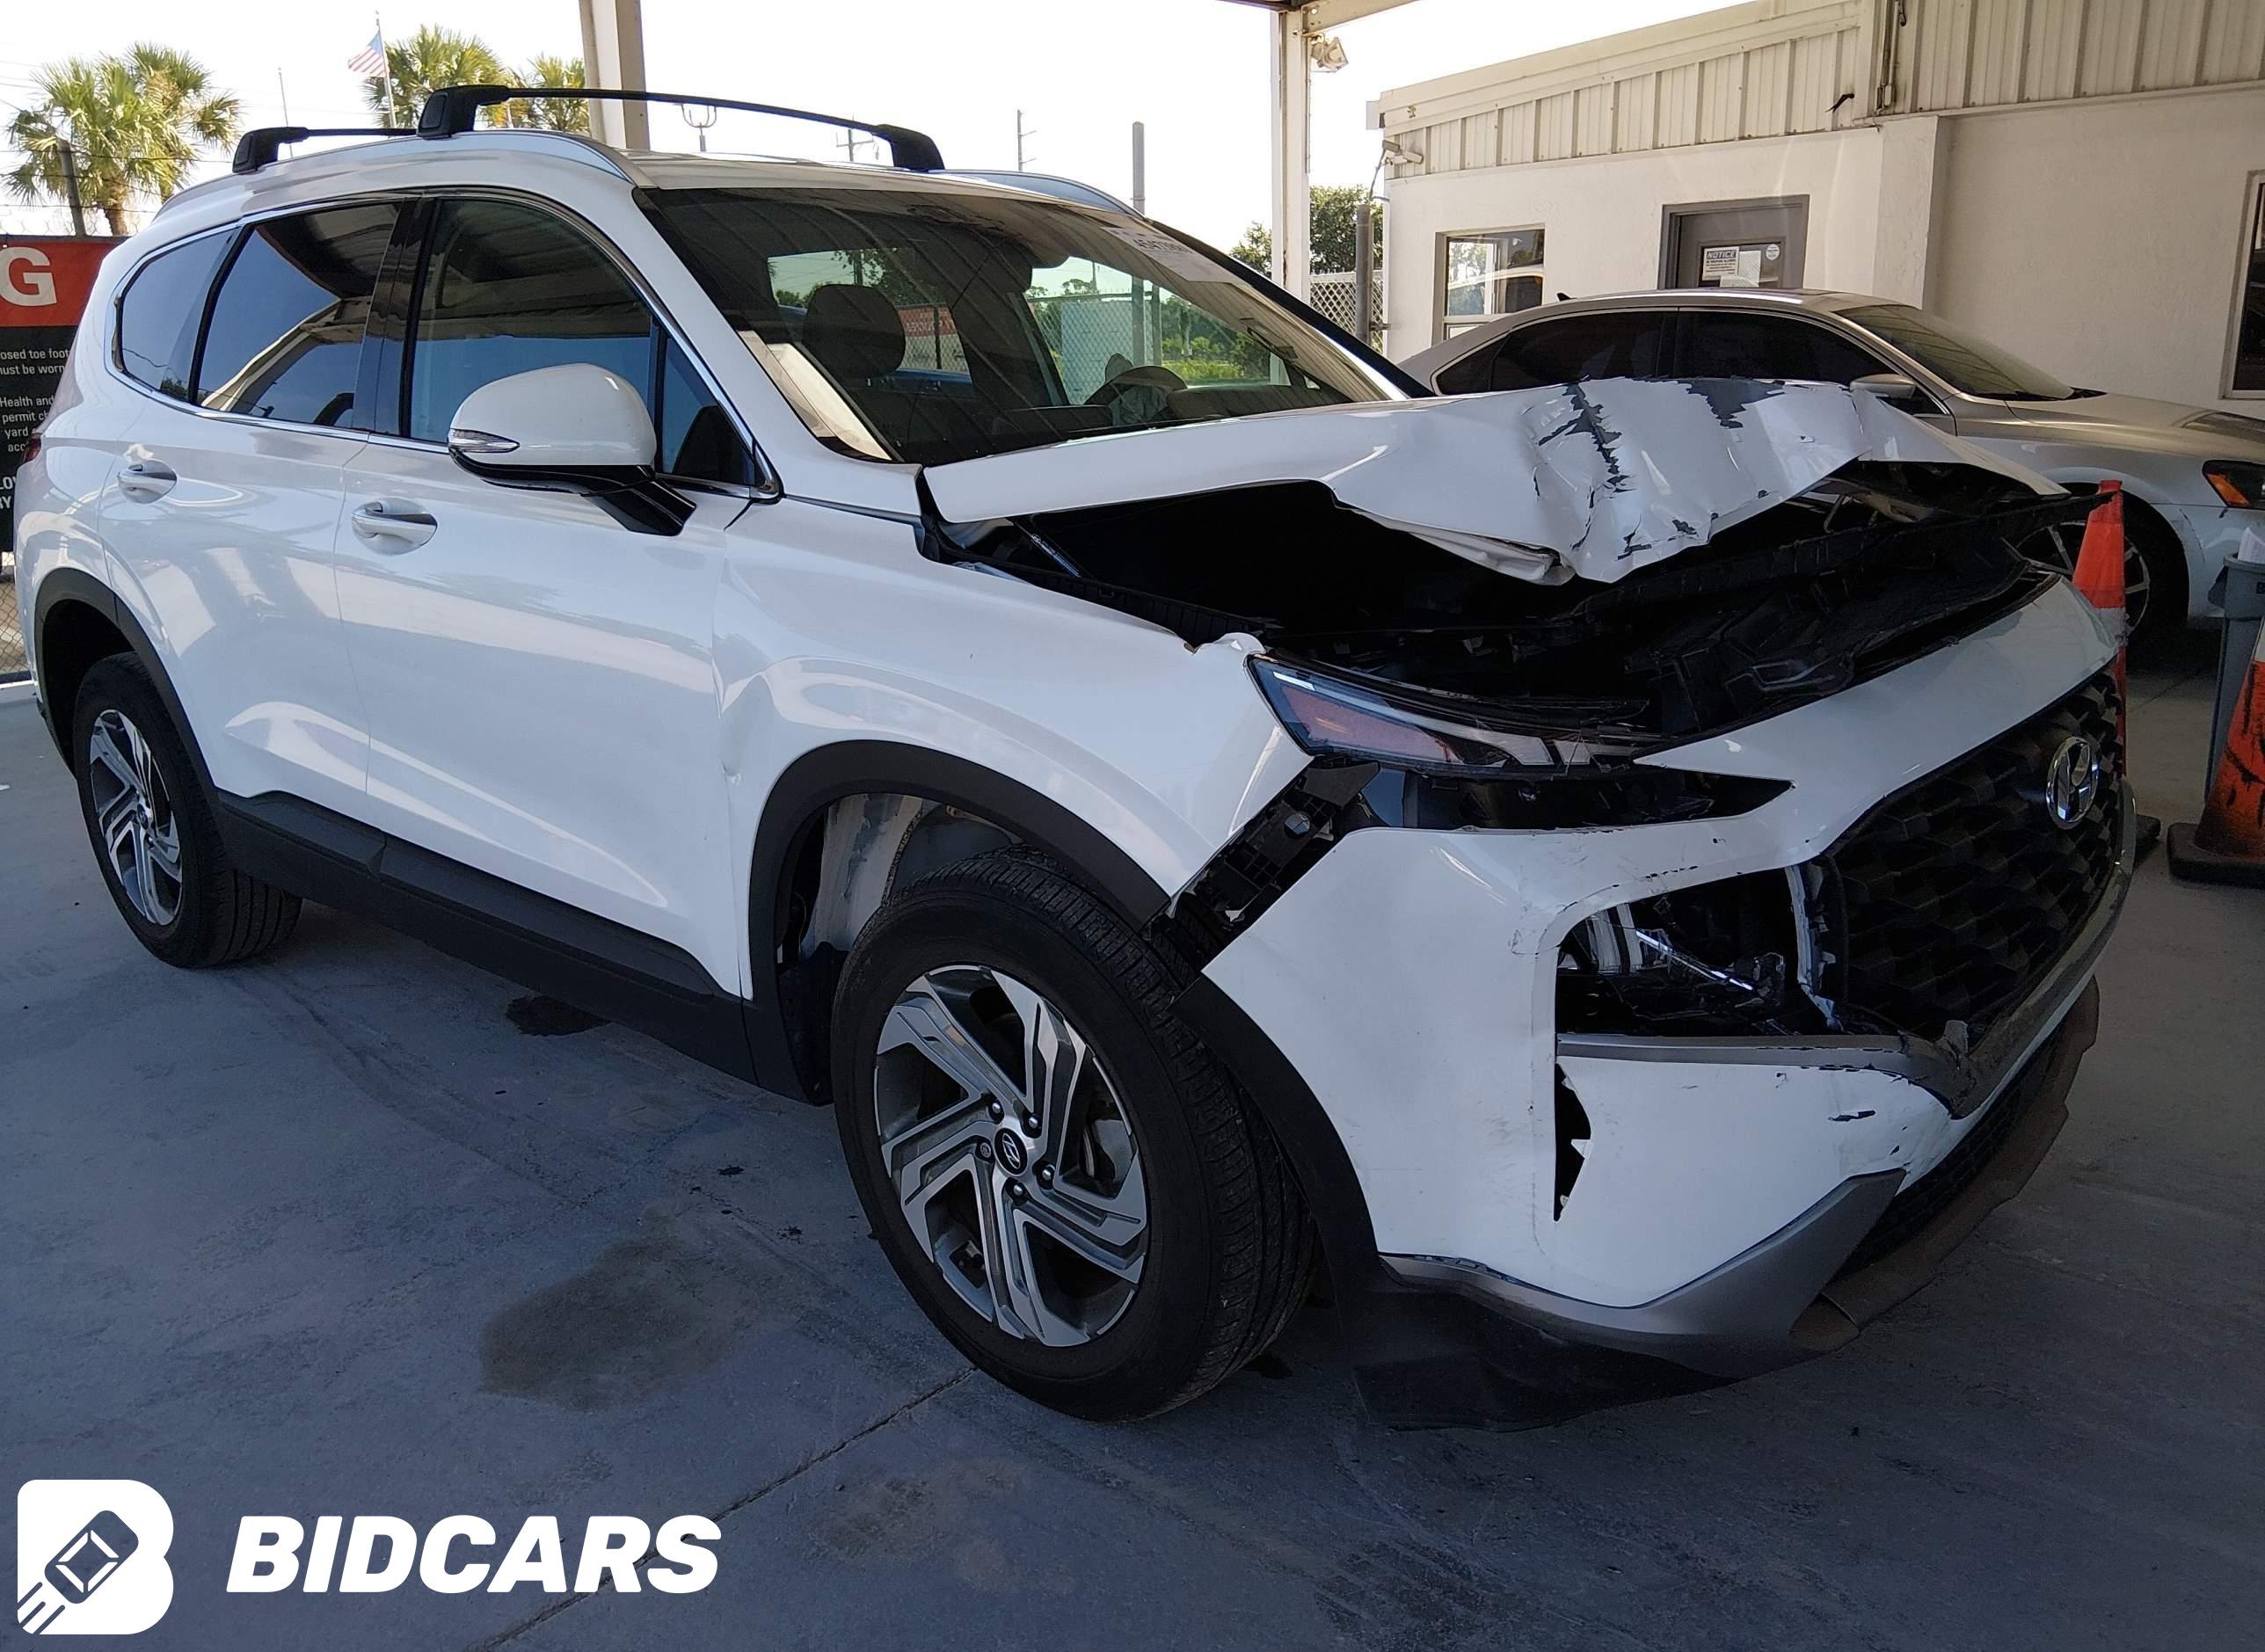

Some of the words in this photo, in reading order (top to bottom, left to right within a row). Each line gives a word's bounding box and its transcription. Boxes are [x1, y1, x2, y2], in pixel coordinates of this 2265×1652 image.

[1707, 251, 1737, 259] NOTICE
[0, 247, 57, 306] G
[28, 349, 46, 360] toe
[22, 364, 35, 375] be
[38, 365, 65, 374] worn
[0, 396, 33, 407] Health
[35, 395, 55, 406] and
[2, 411, 36, 425] permit
[4, 426, 29, 440] yard
